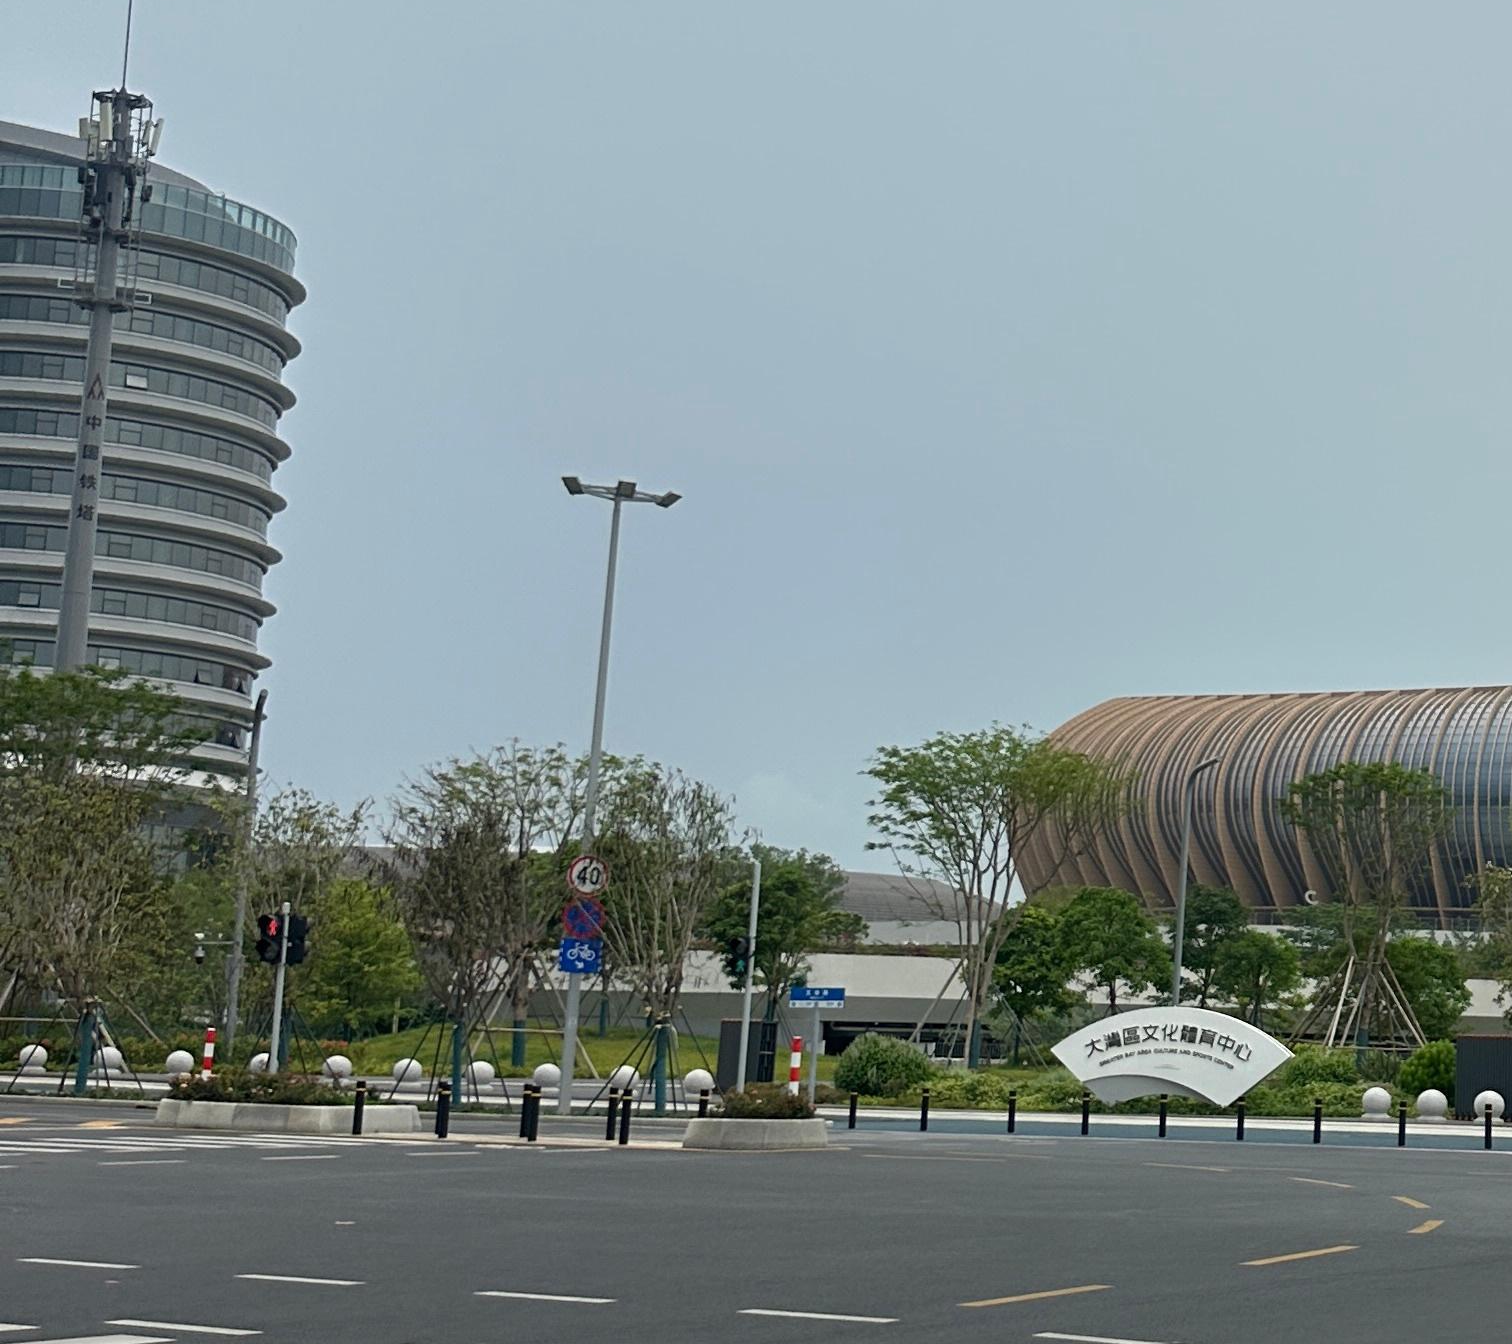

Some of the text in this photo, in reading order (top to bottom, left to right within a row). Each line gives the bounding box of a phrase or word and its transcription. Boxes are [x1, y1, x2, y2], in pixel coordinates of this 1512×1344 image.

[76, 415, 102, 521] 中国铁塔
[577, 866, 600, 885] 40
[1085, 1024, 1252, 1062] 大灣區文化體育中心
